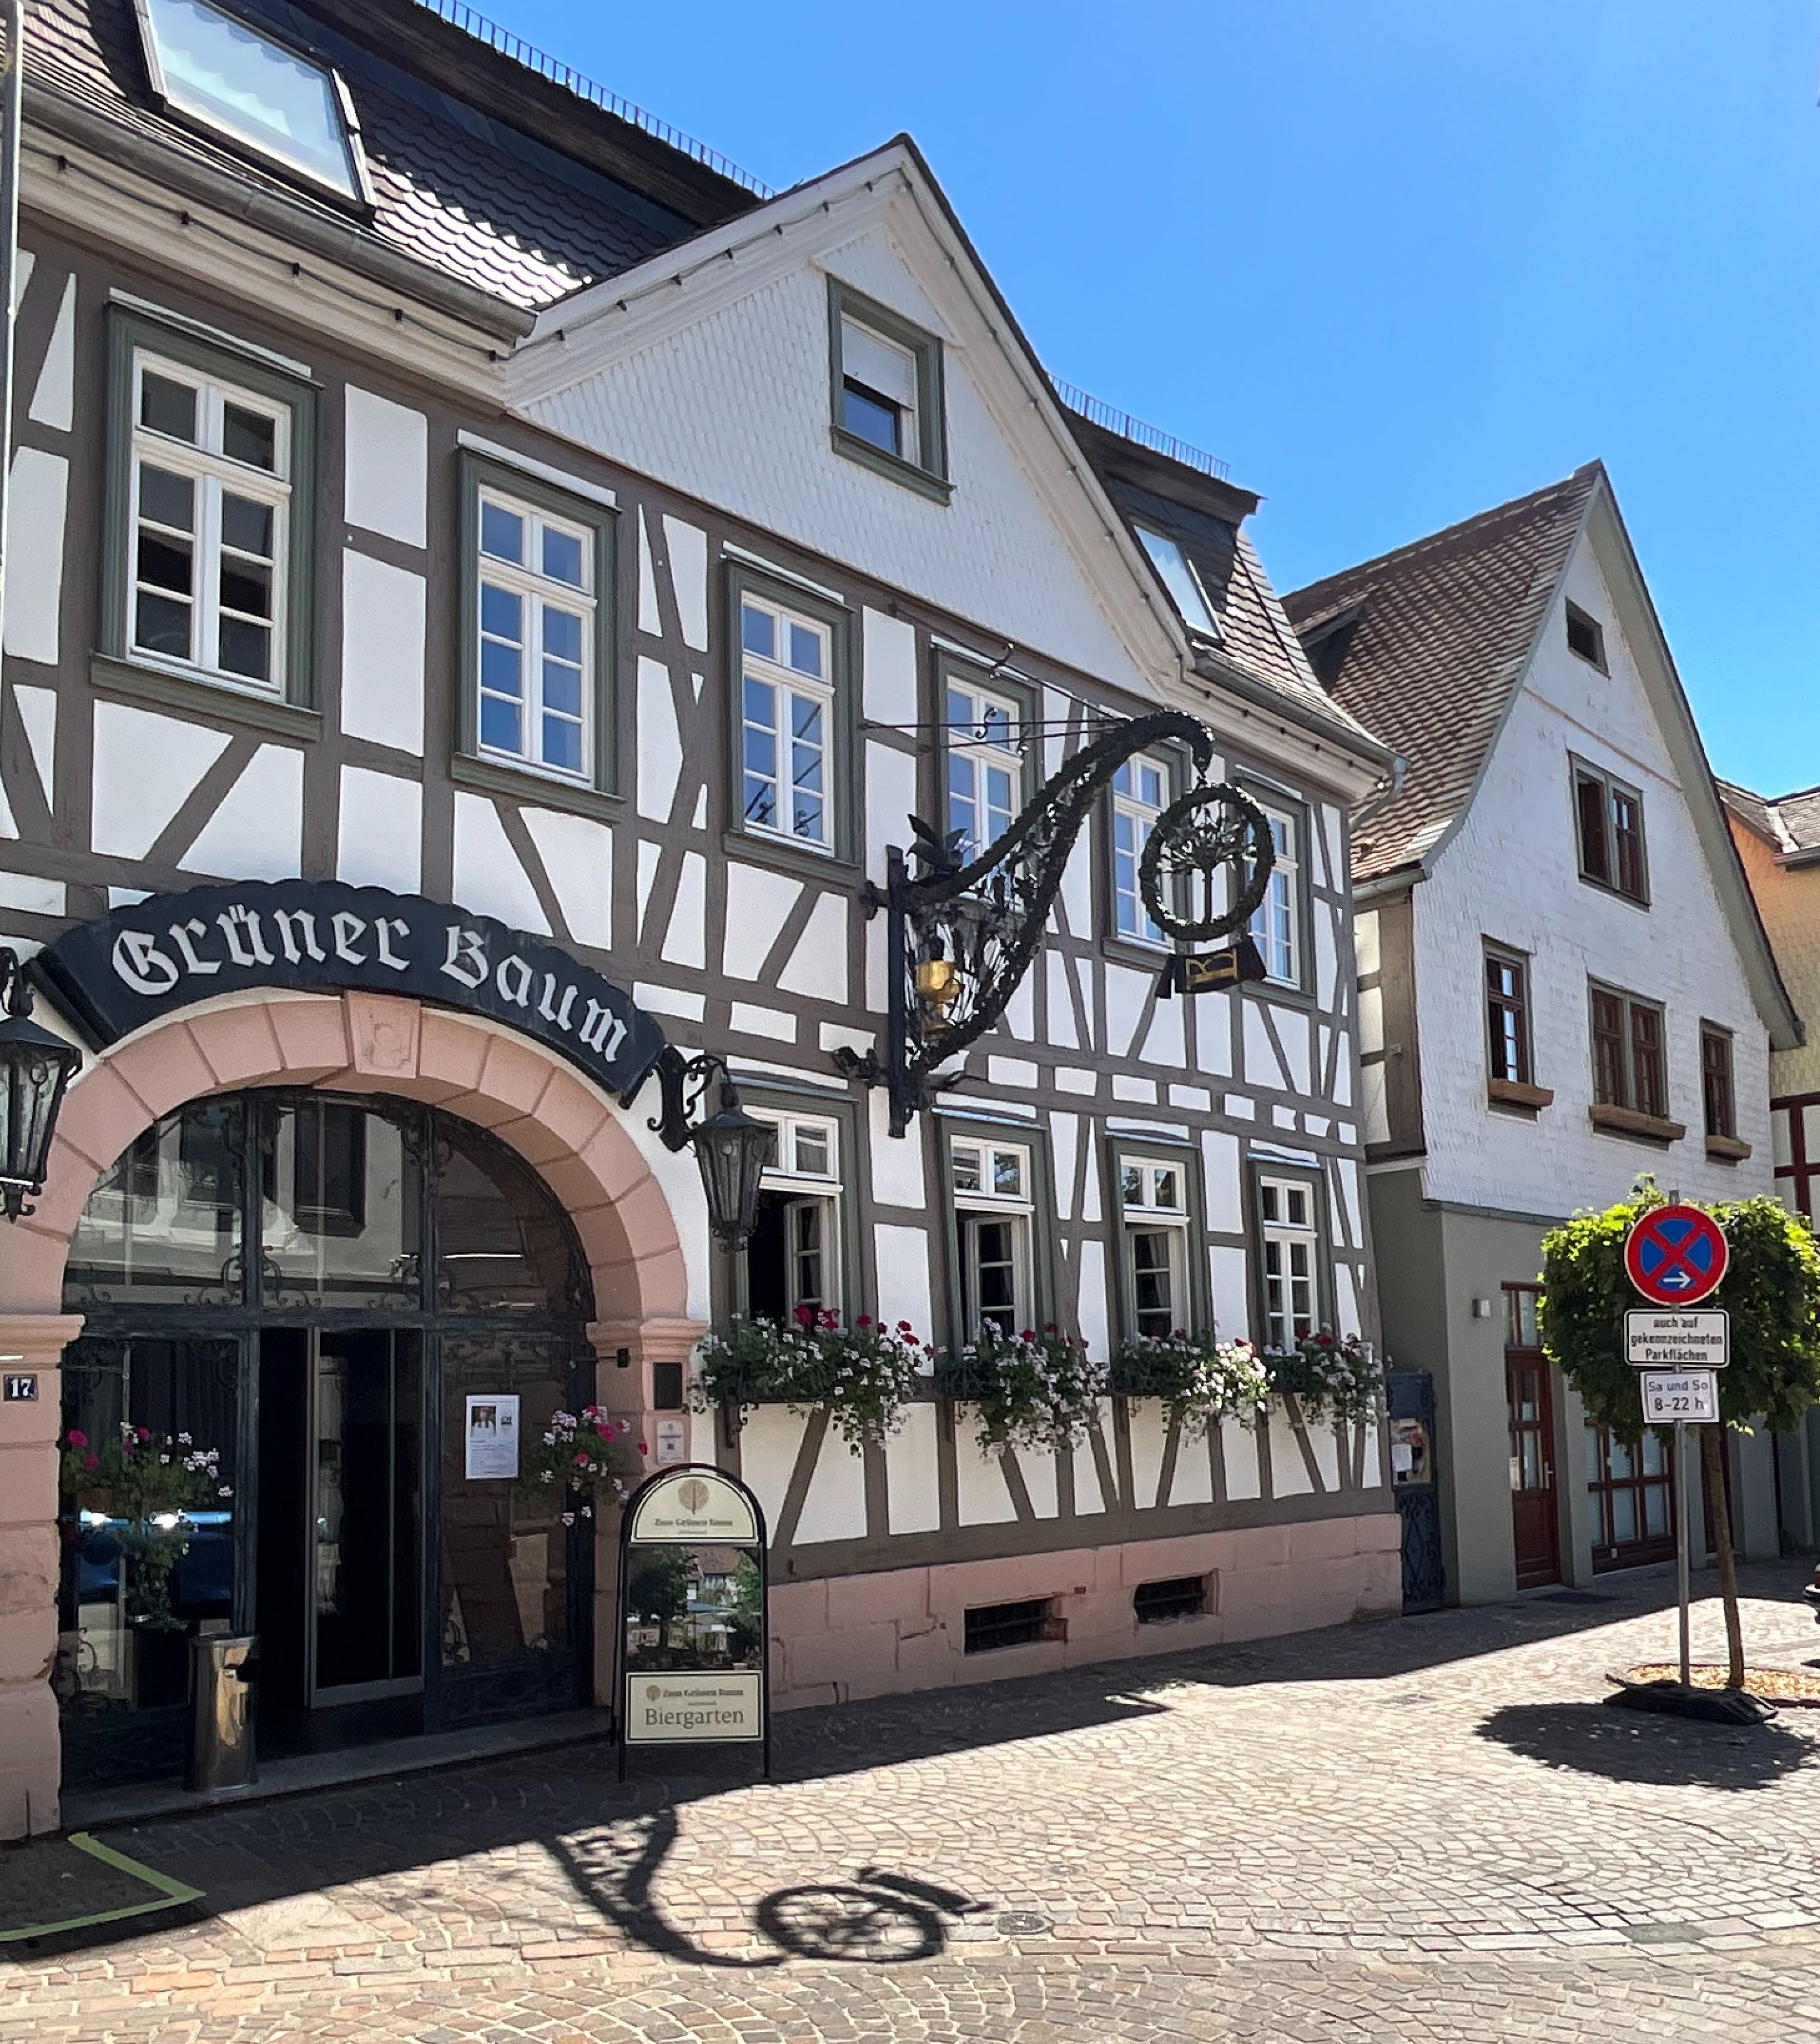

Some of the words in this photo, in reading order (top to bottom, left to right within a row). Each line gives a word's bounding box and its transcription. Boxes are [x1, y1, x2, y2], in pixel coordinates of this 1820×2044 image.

[110, 904, 411, 996] Grüner
[439, 925, 629, 1063] Baum
[1653, 1316, 1678, 1328] auch
[1681, 1316, 1698, 1328] auf
[1630, 1331, 1723, 1348] gekennzeichneten
[1645, 1348, 1708, 1361] Parkflächen
[11, 1378, 32, 1397] 17
[1648, 1380, 1663, 1392] Sa
[1667, 1380, 1688, 1391] und
[1692, 1379, 1709, 1391] So
[1695, 1396, 1705, 1410] h
[645, 1706, 744, 1730] Biergarten
